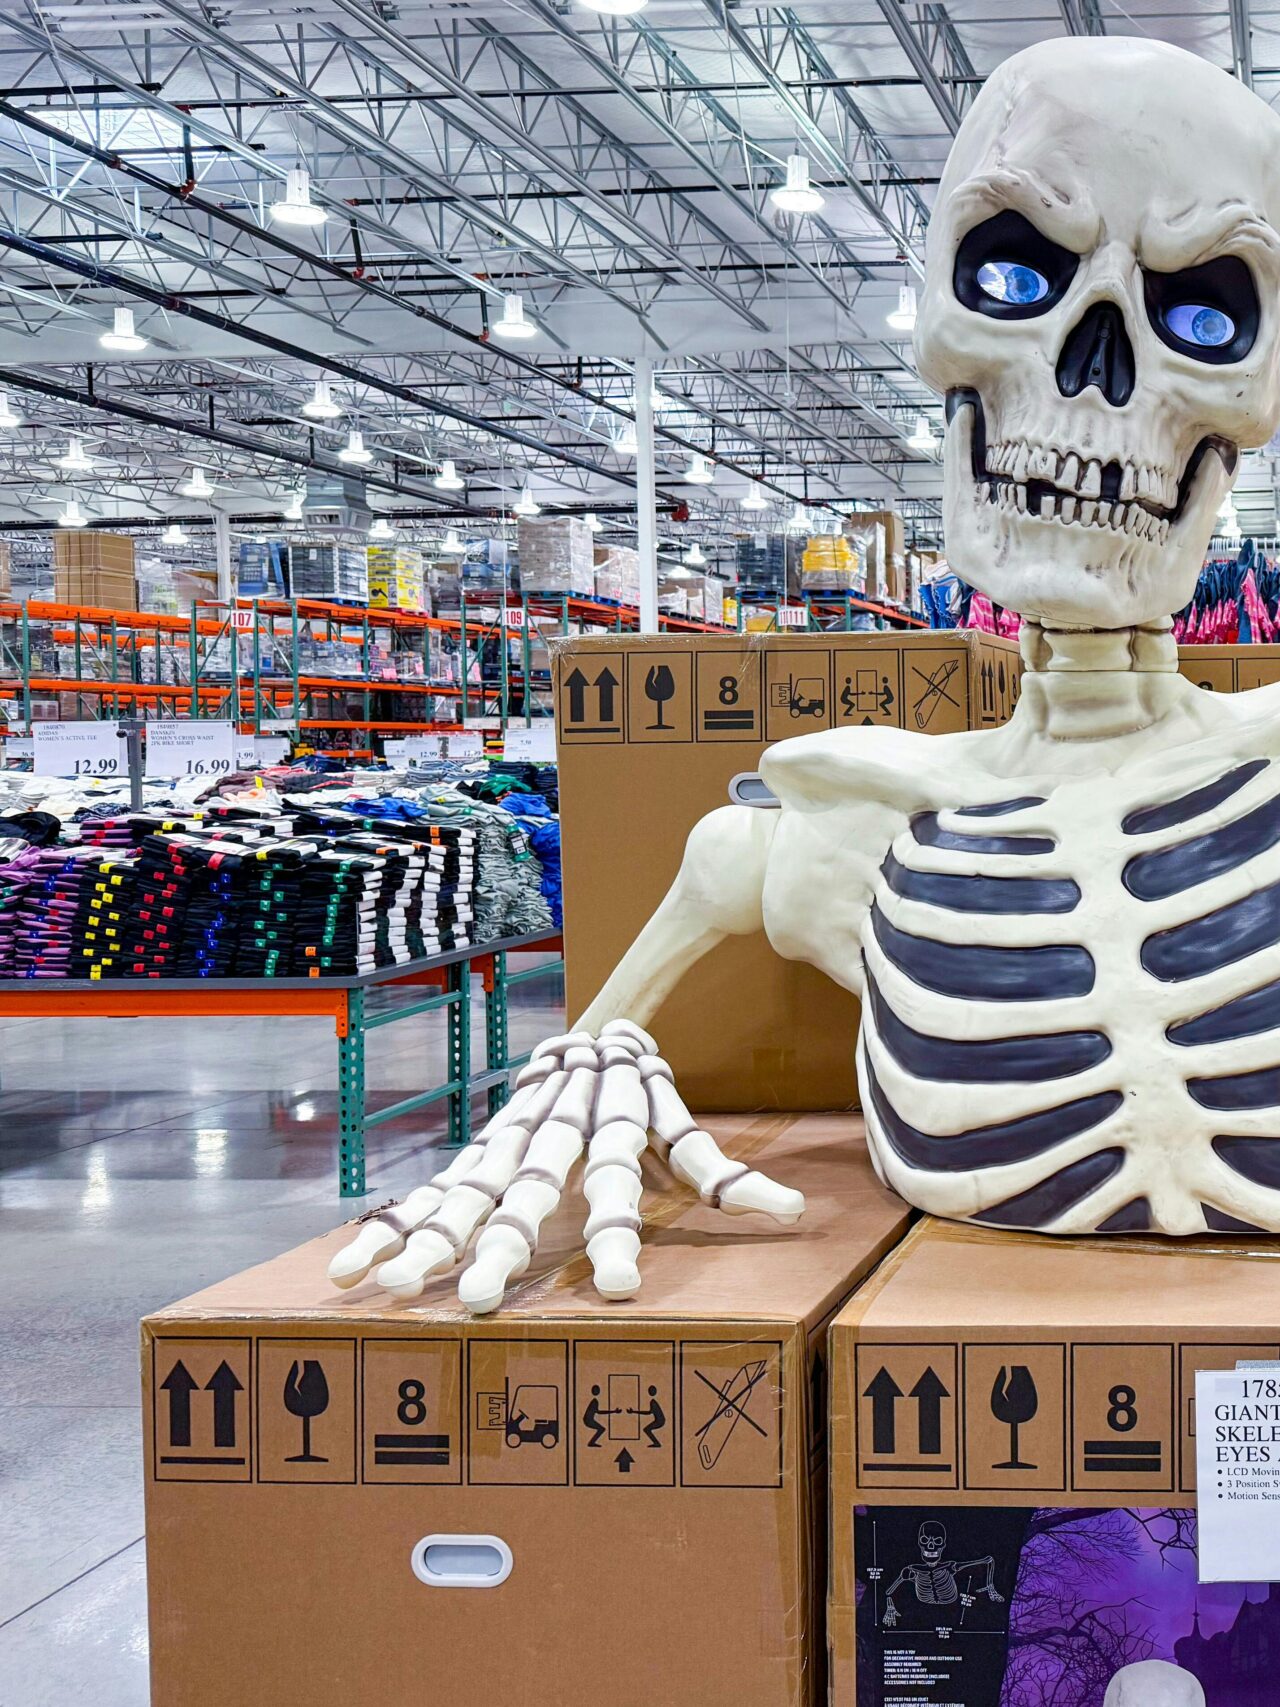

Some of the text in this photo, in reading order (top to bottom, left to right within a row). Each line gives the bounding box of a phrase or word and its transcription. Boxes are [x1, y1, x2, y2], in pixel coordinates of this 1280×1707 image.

[232, 612, 251, 626] 107
[506, 611, 522, 625] 109
[719, 676, 739, 706] 8
[73, 758, 118, 775] 12.99
[185, 759, 230, 775] 16.99
[397, 1379, 426, 1425] 8
[1107, 1385, 1137, 1432] 8
[1216, 1446, 1270, 1462] EYES
[1227, 1468, 1248, 1476] LCD
[1227, 1480, 1232, 1488] 3
[1235, 1480, 1271, 1488] Position
[1227, 1492, 1259, 1500] Motion
